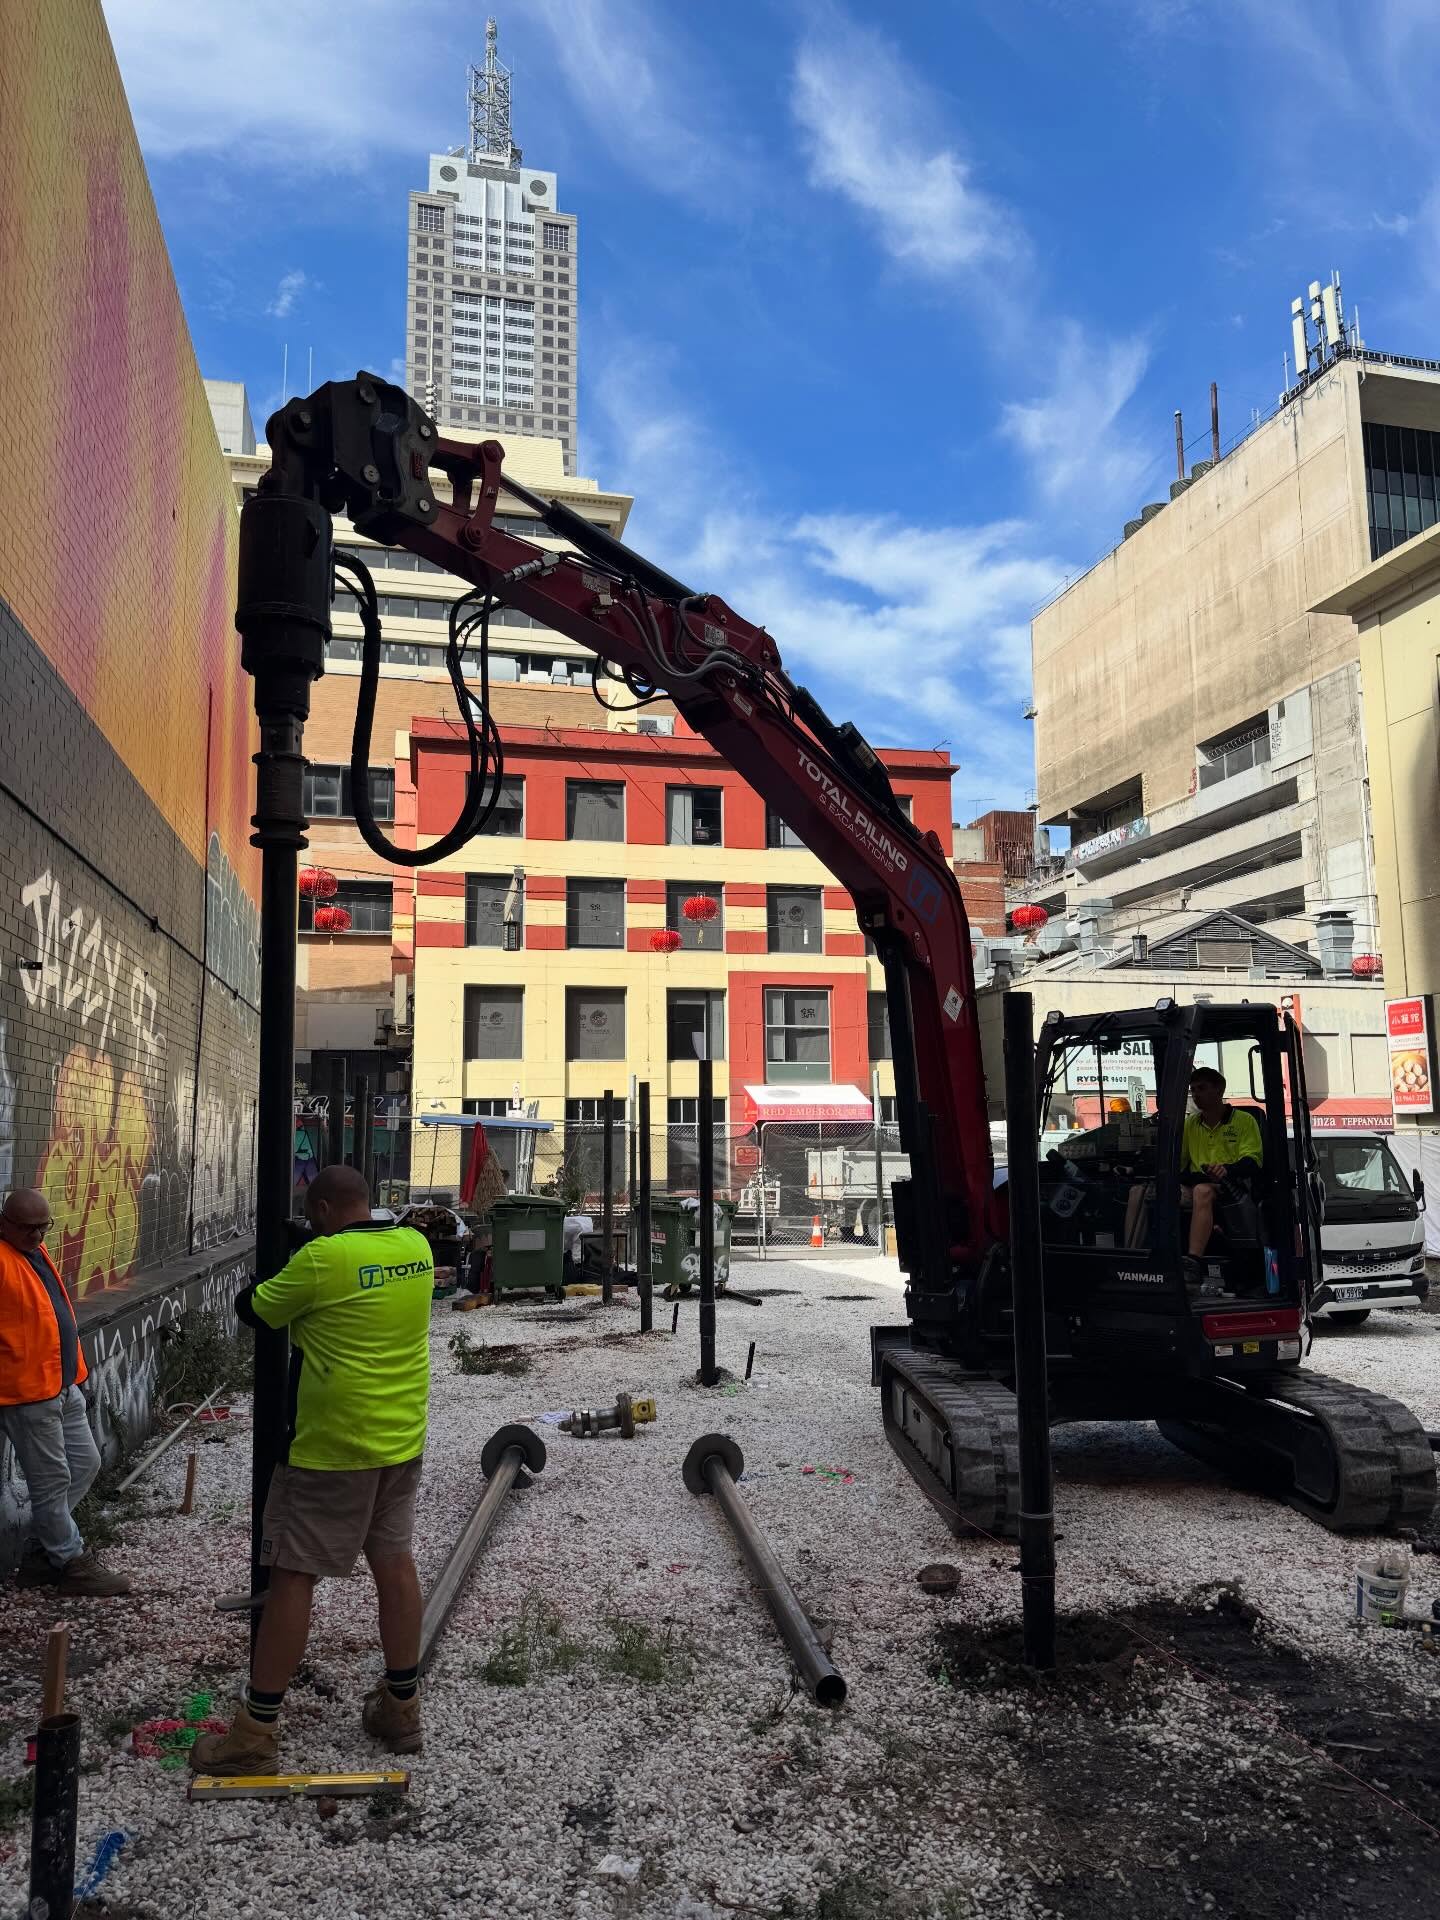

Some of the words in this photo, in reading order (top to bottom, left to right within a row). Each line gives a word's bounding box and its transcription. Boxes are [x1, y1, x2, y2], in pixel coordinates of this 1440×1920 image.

[797, 748, 852, 817] TOTAL
[854, 810, 908, 872] PILING
[818, 794, 827, 806] &
[828, 806, 894, 873] EXCAVATIONS
[763, 1108, 785, 1116] RED
[789, 1108, 841, 1116] EMPEROR
[1312, 1117, 1336, 1127] inza
[1341, 1117, 1392, 1126] TEPPANYAKI
[383, 1258, 432, 1278] TOTAL
[1117, 1271, 1164, 1284] YANMAR
